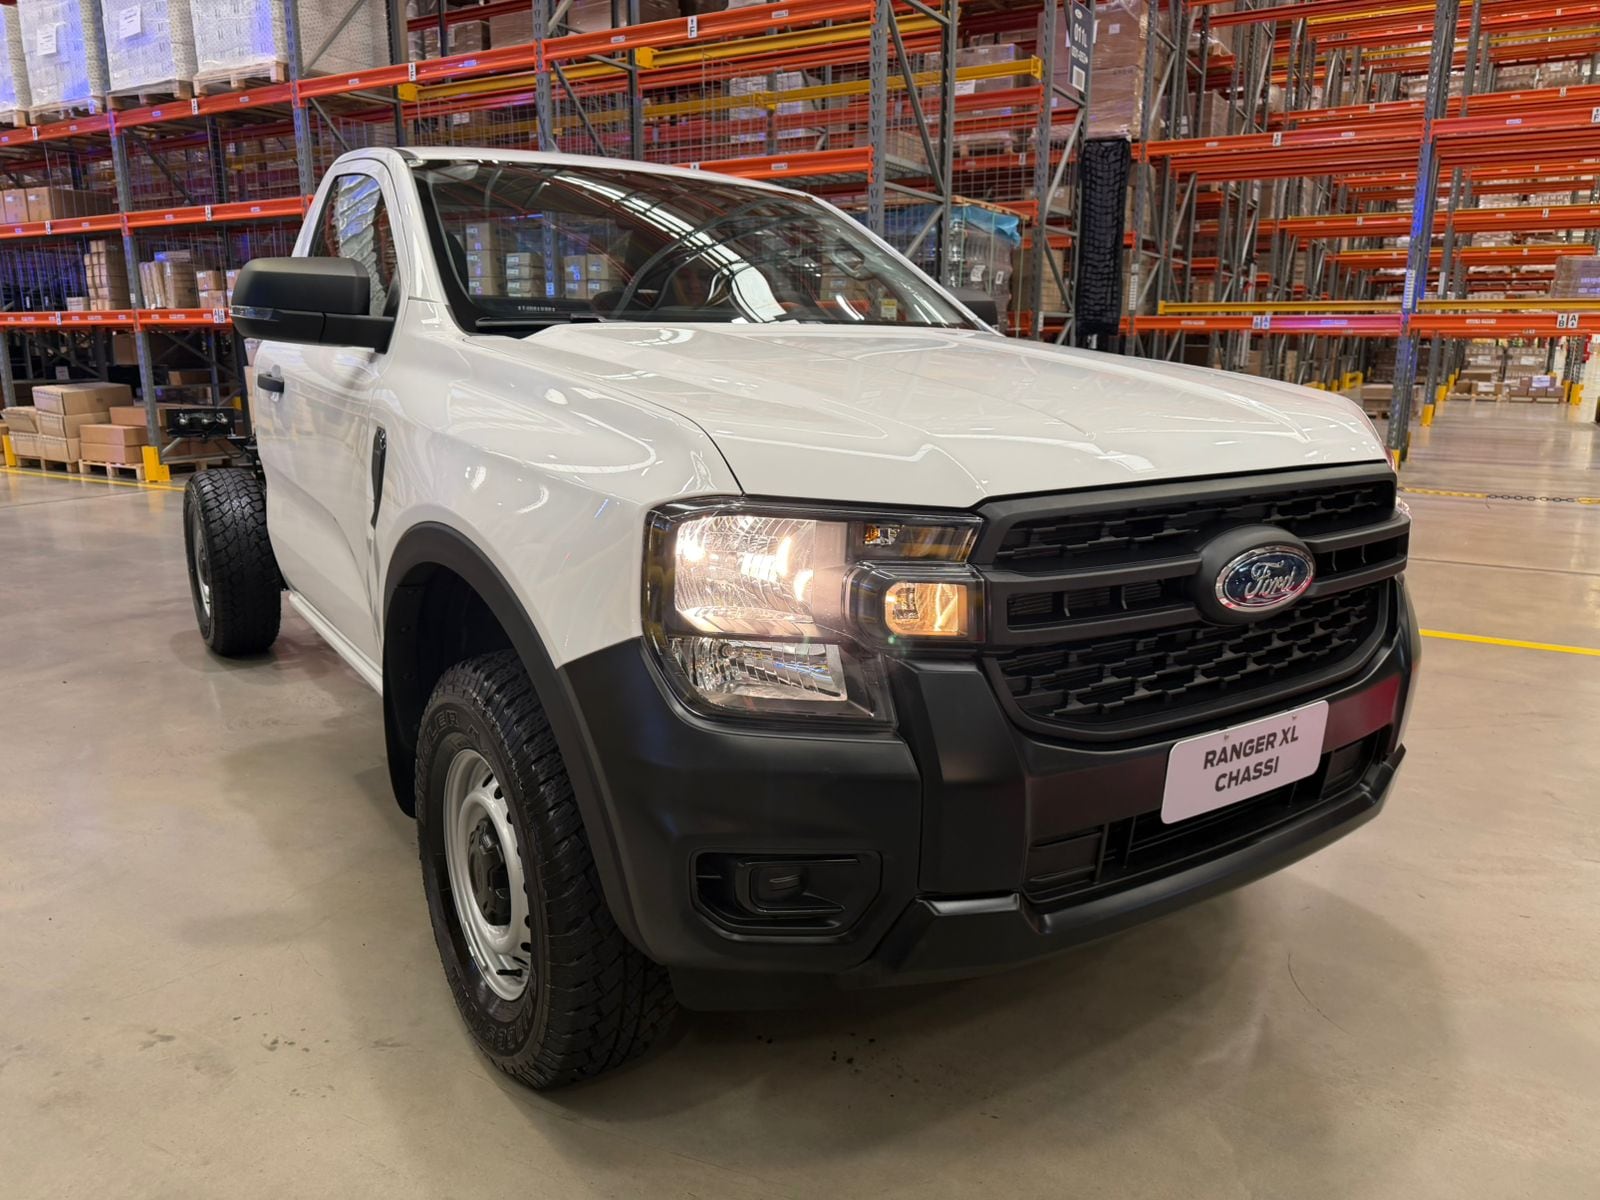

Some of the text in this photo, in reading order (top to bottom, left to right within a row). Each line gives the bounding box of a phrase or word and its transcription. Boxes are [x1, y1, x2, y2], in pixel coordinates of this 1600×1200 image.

[1244, 561, 1296, 599] Ford
[1203, 725, 1299, 770] RANGER XL
[1214, 756, 1279, 792] CHASSI
